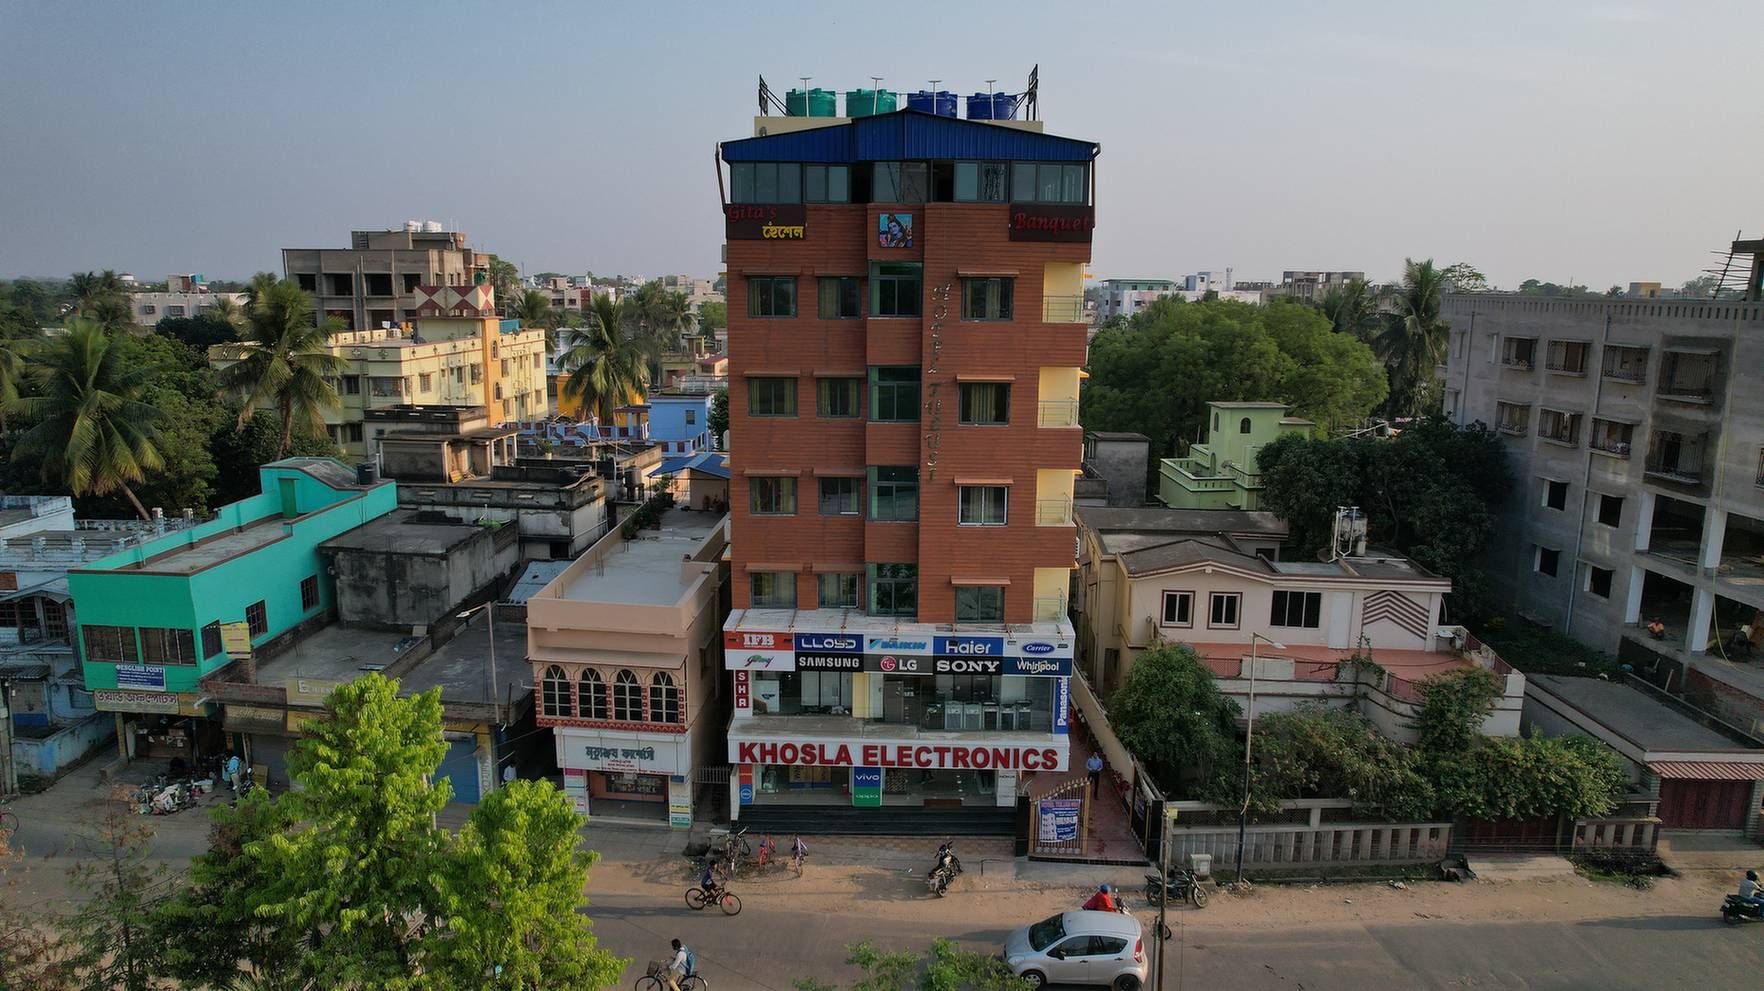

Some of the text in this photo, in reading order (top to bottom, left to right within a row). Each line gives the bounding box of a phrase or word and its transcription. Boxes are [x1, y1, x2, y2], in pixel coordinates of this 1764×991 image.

[1015, 212, 1090, 236] Banquet
[743, 633, 774, 646] IFB
[801, 638, 857, 649] LLOYD
[946, 640, 991, 654] Haier
[1026, 644, 1052, 652] Carrier
[799, 656, 860, 668] SAMSUNG
[899, 659, 917, 671] LG
[936, 660, 1000, 672] SONY
[1017, 658, 1060, 673] Whirlpool
[739, 742, 1058, 769] KHOSLA ELECTRONICS
[855, 773, 880, 781] vivo
